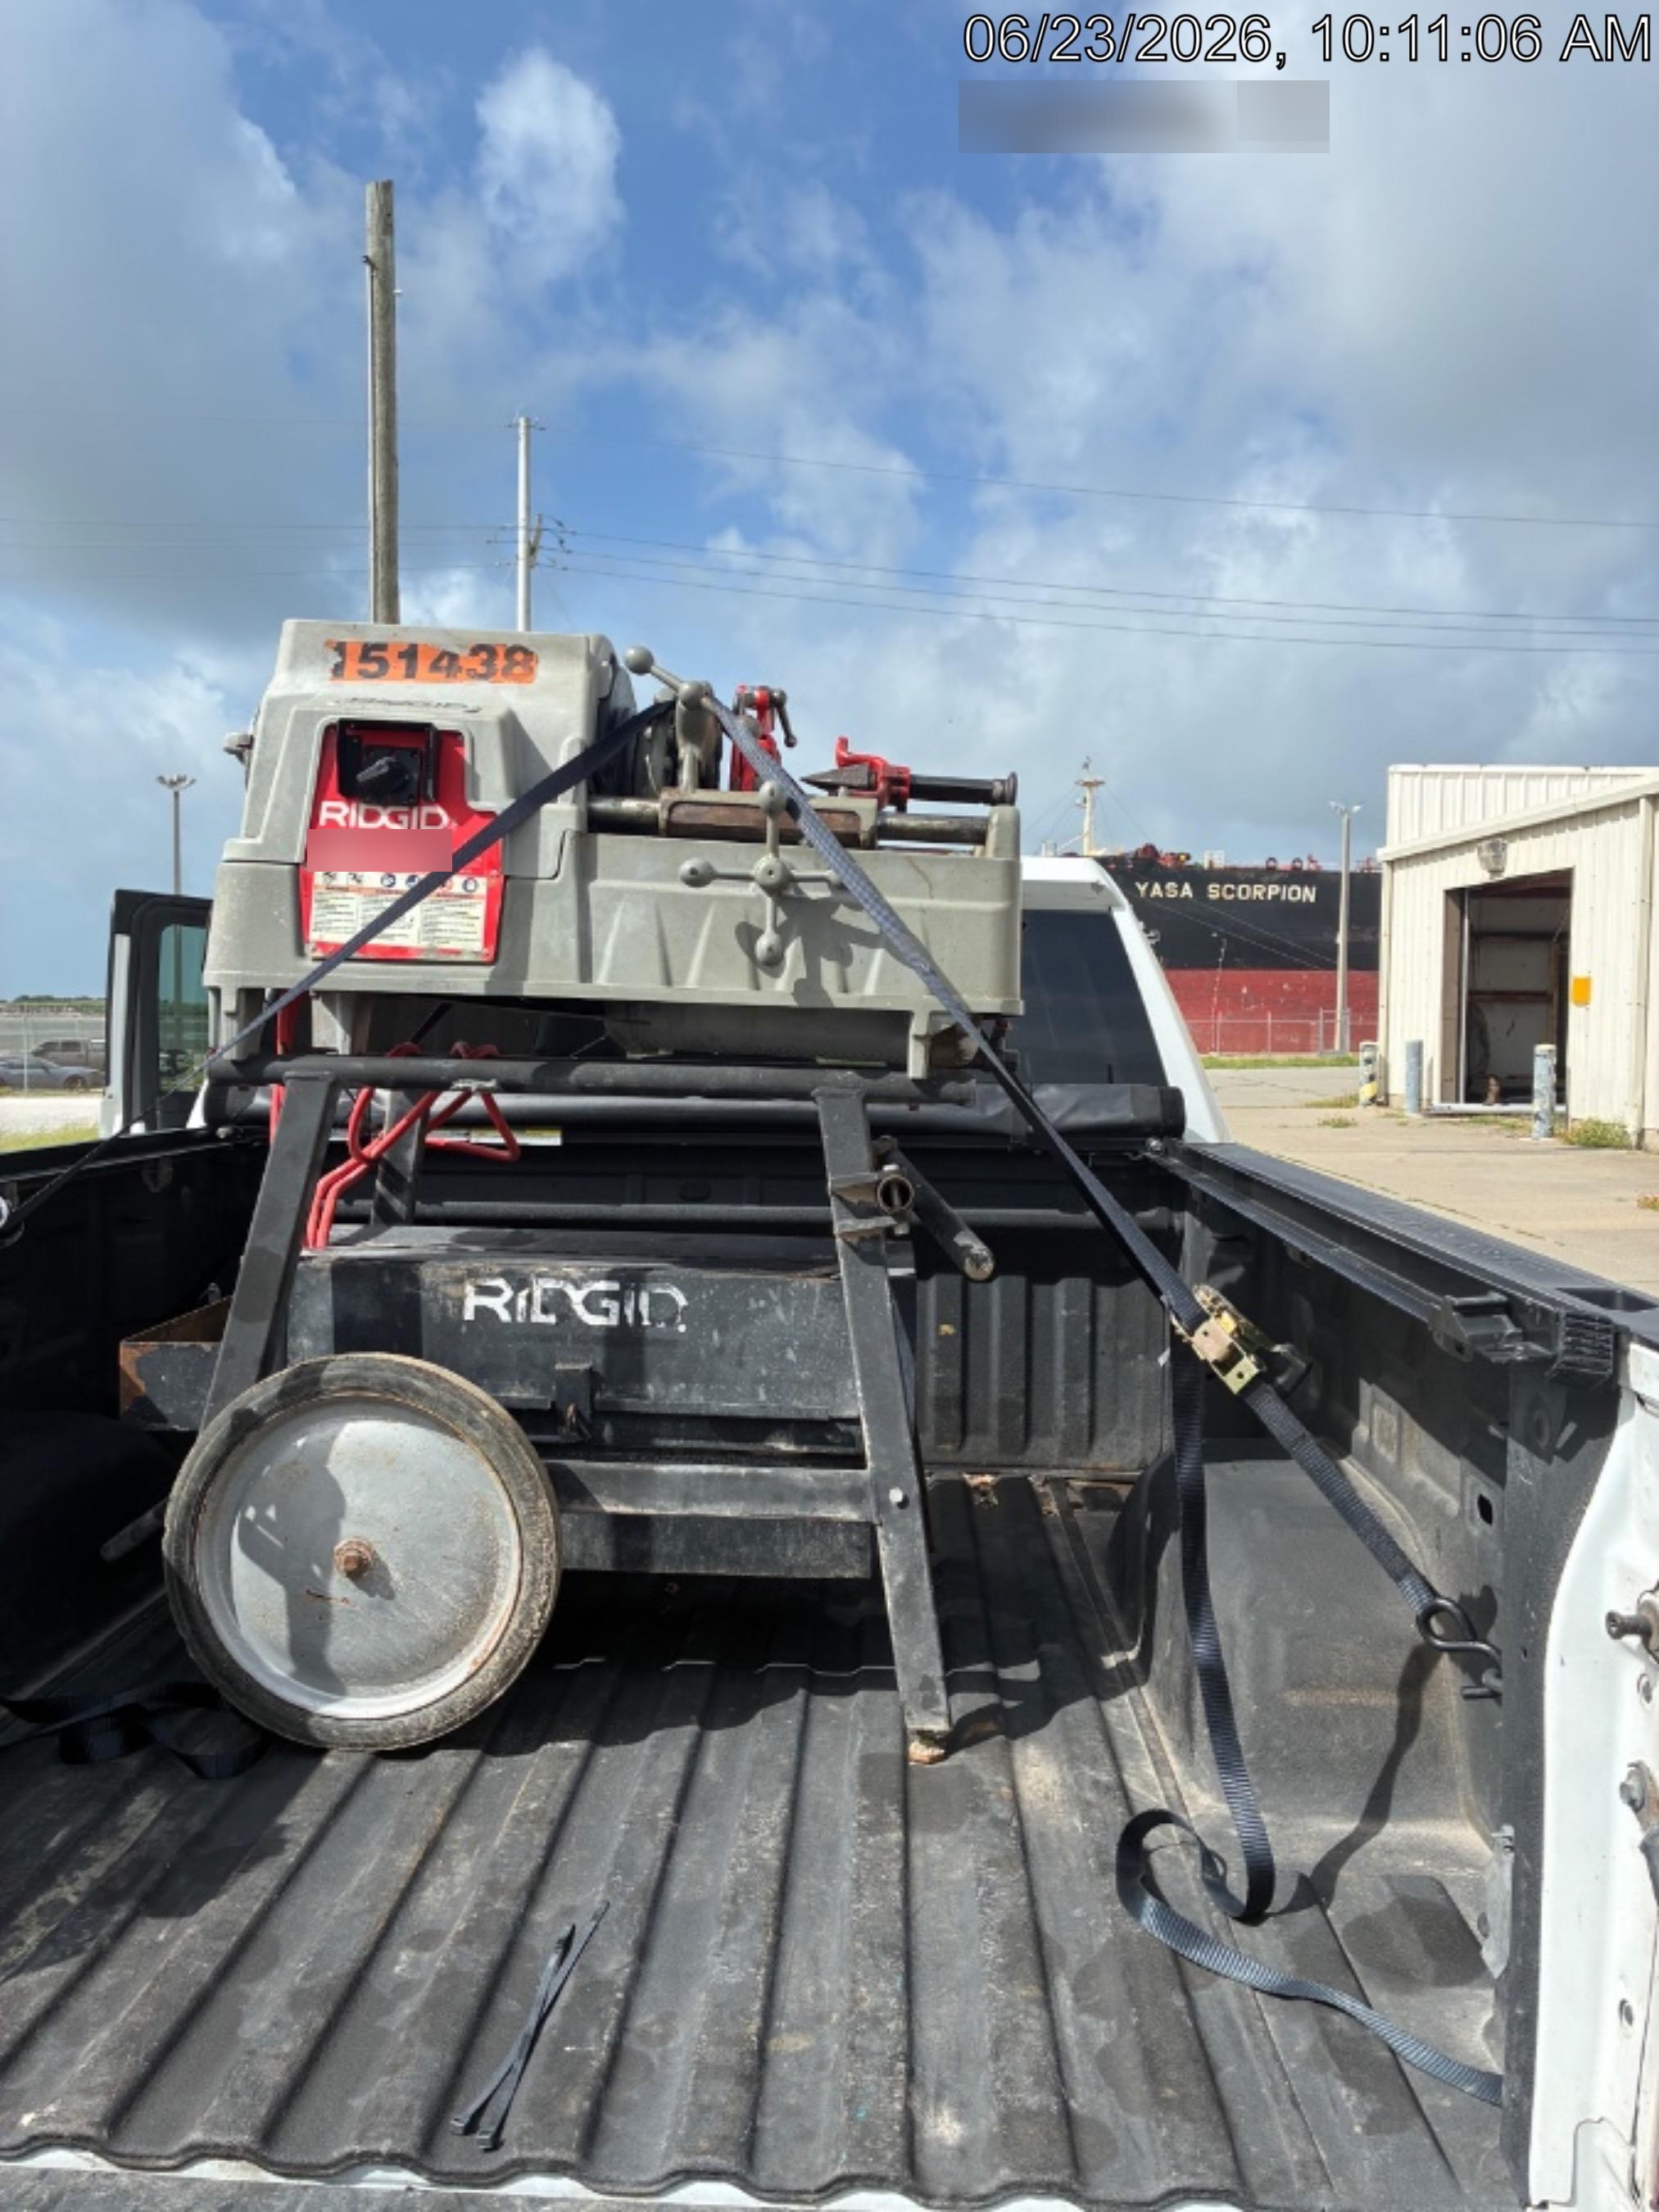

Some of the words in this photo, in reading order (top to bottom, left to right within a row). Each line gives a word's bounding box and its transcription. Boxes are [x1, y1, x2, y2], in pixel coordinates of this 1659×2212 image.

[332, 641, 537, 680] 151438
[319, 800, 451, 829] RIDGID
[1135, 882, 1193, 899] YASA
[1207, 883, 1317, 903] SCORPION
